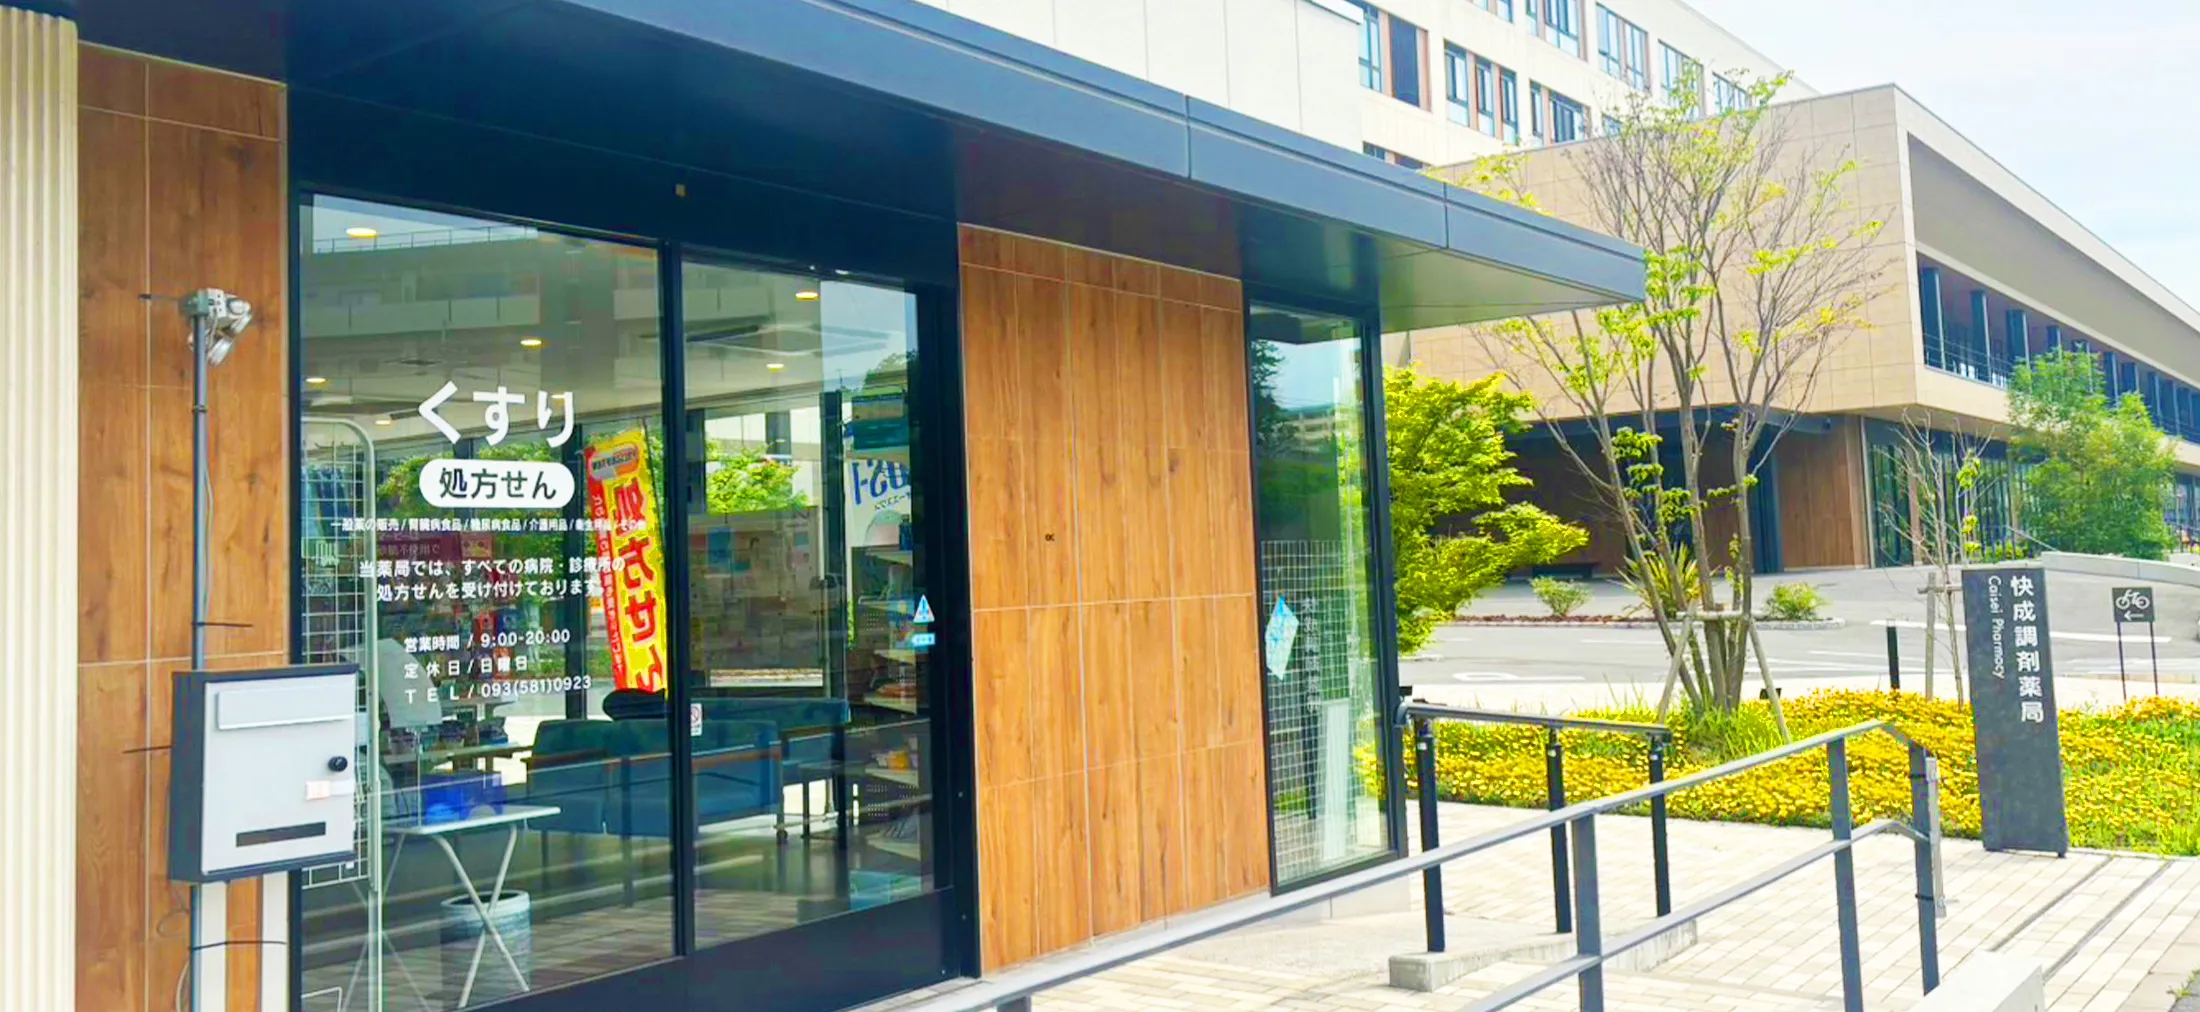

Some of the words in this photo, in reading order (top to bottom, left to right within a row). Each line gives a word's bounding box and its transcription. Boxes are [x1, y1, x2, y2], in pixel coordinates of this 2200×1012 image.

[418, 380, 577, 448] くすり
[439, 467, 557, 500] 処方せん
[613, 475, 667, 694] 処方せん
[1988, 575, 2004, 614] Caisei
[404, 634, 460, 653] 営業時間
[480, 629, 571, 648] 9:00-20:00
[1992, 617, 2005, 679] Pharmacy
[2010, 575, 2044, 724] 快成調剤薬局
[404, 660, 460, 680] 定休日
[480, 655, 528, 674] 日曜日
[405, 686, 460, 705] TEL
[480, 675, 592, 699] 093(581)0923
